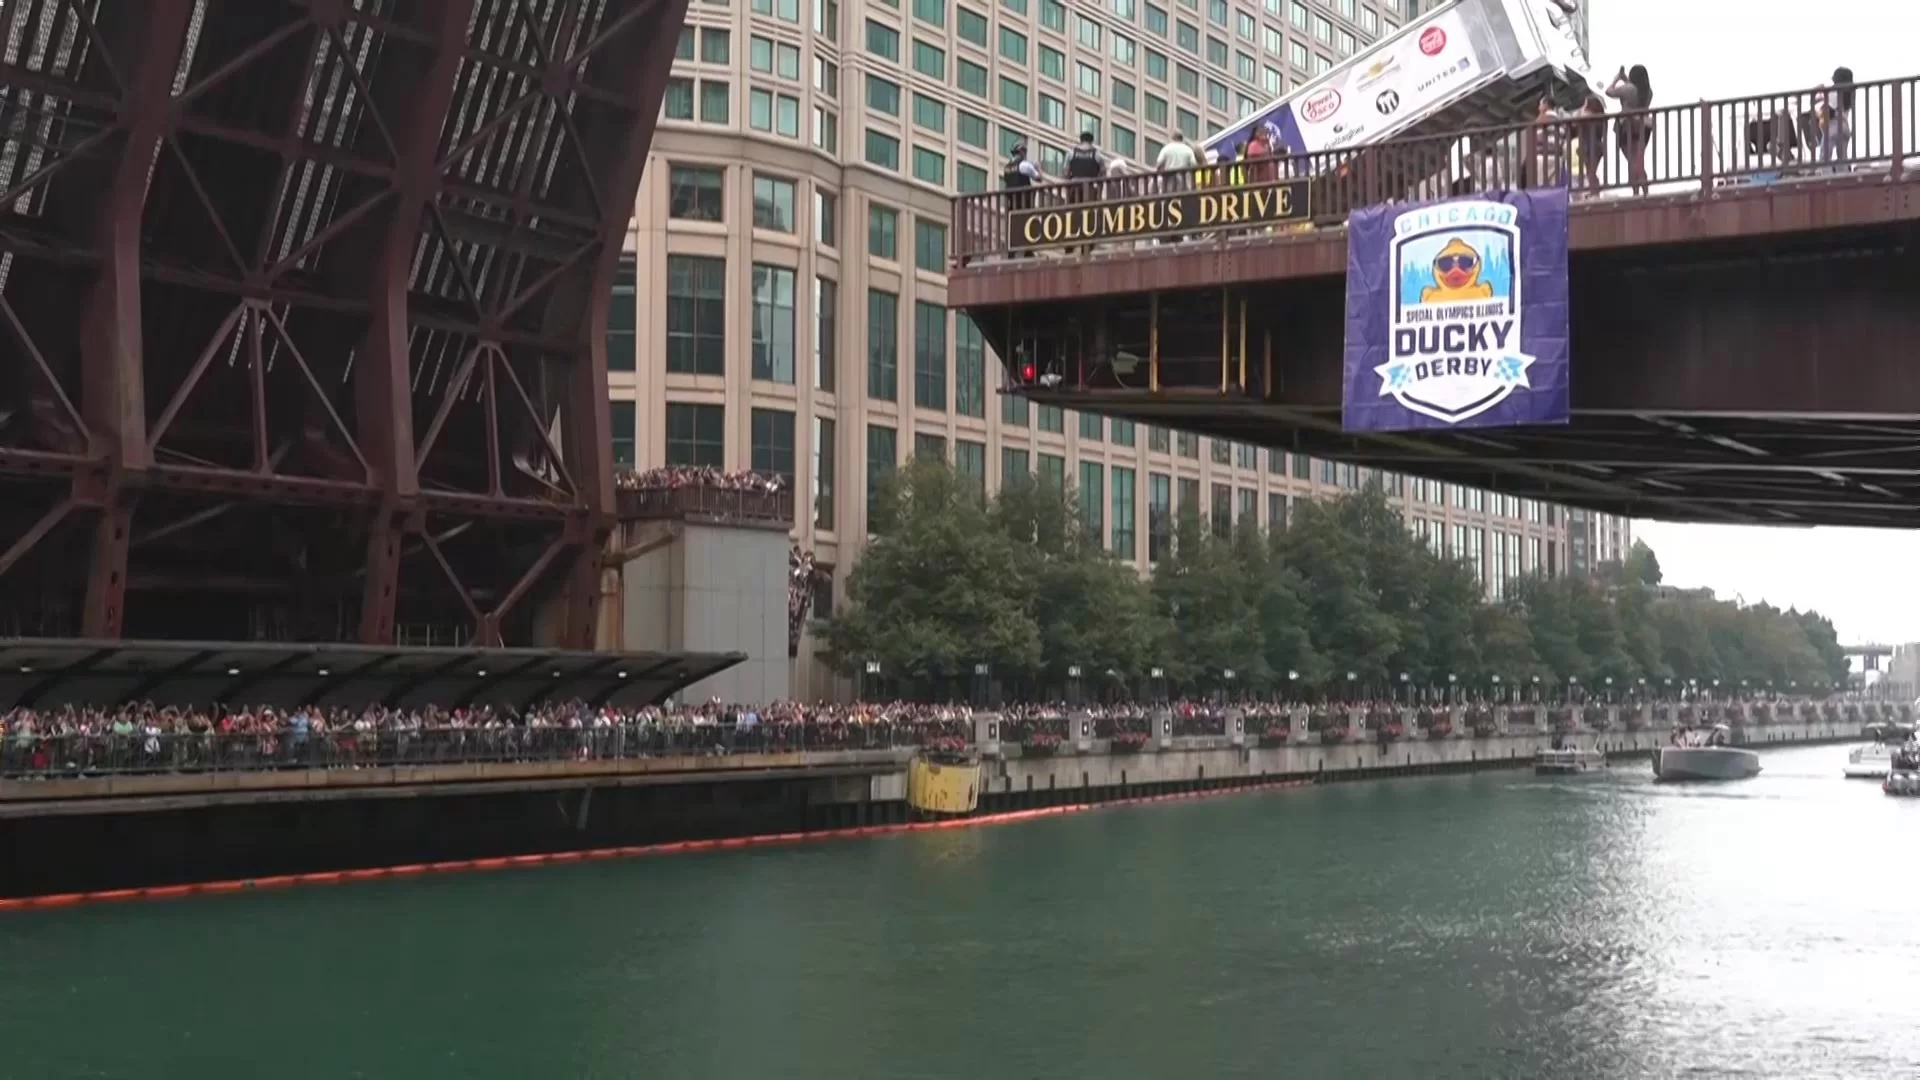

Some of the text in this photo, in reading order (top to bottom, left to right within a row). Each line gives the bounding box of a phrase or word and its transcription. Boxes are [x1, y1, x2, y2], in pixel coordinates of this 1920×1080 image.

[1417, 66, 1457, 92] UNITED
[1023, 187, 1293, 244] COLUMBUS DRIVE
[1400, 206, 1512, 233] CHICAGO
[1406, 302, 1504, 323] SPECIAL OLYMPICS ILLINOIS
[1395, 319, 1514, 357] DUCKY
[1415, 356, 1493, 381] DERBY
